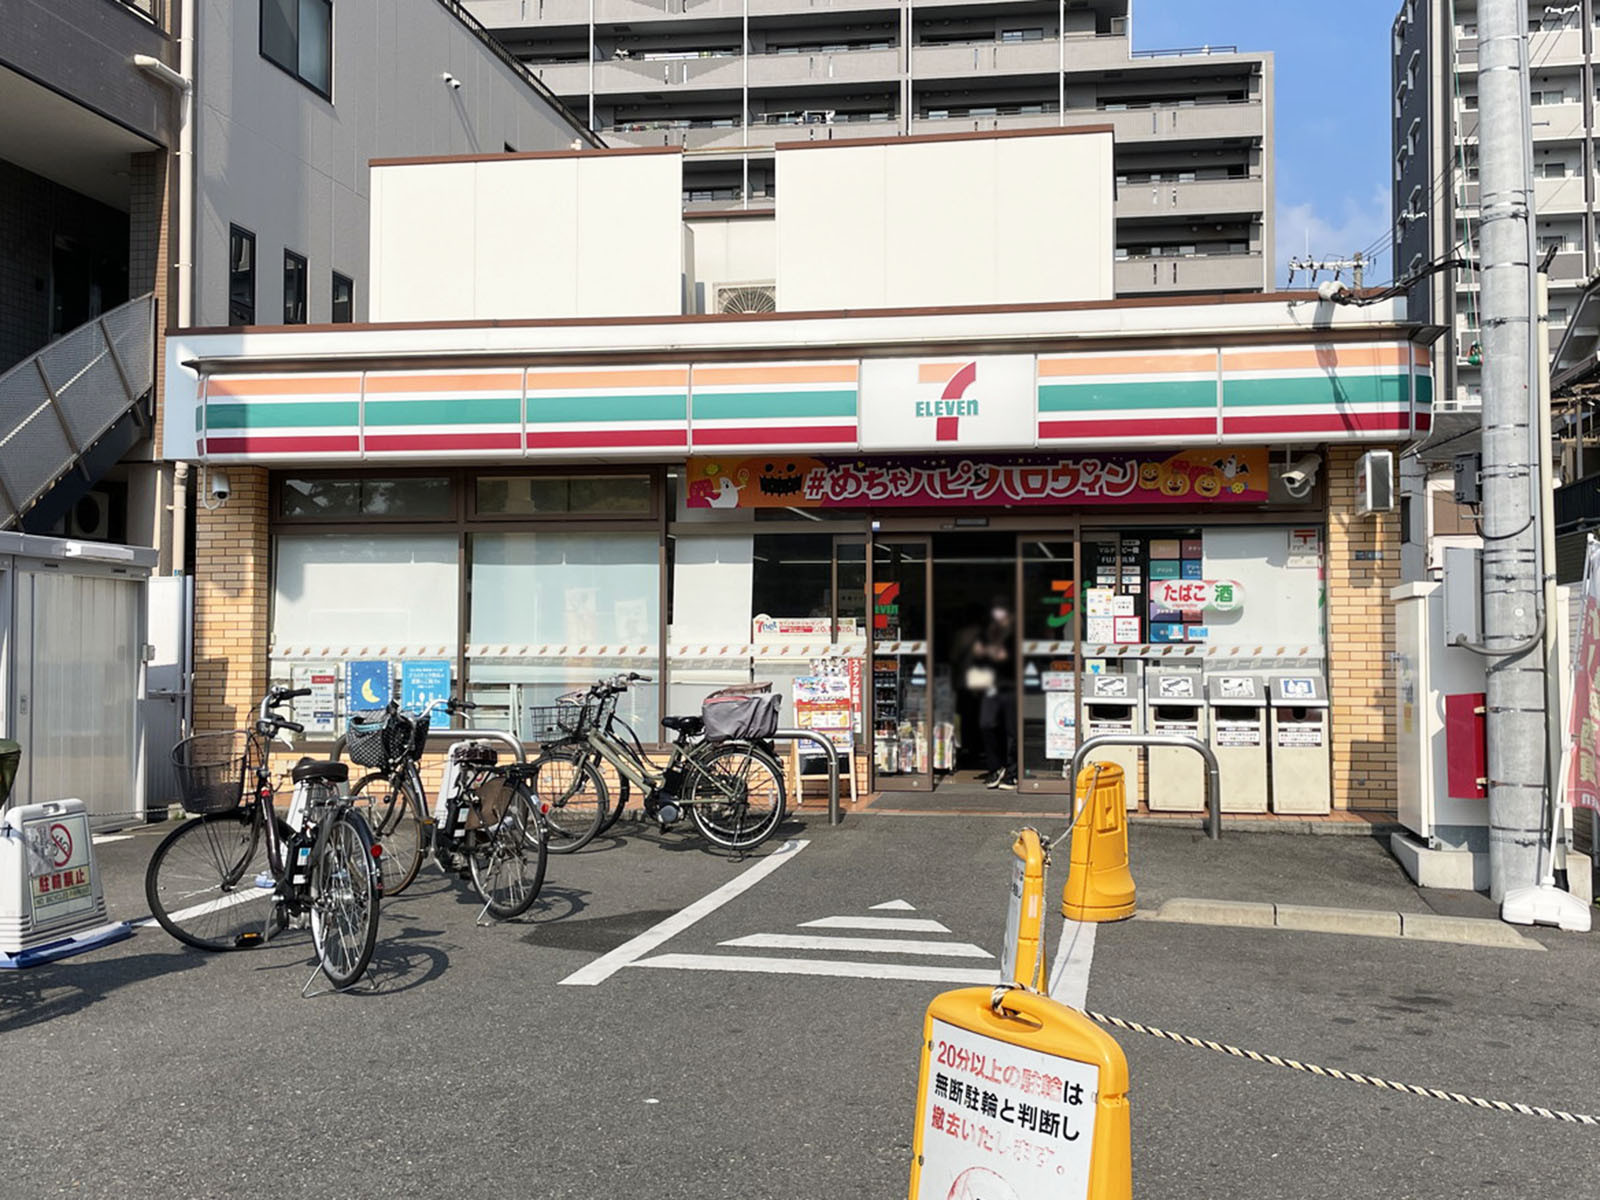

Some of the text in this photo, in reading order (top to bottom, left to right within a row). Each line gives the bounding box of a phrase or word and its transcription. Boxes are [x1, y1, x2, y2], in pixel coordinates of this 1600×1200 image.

[1164, 584, 1206, 602] たばこ
[1214, 585, 1233, 602] 酒
[39, 868, 86, 892] 駐輪禁止
[934, 1072, 1079, 1141] 無断駐輪と判断し
